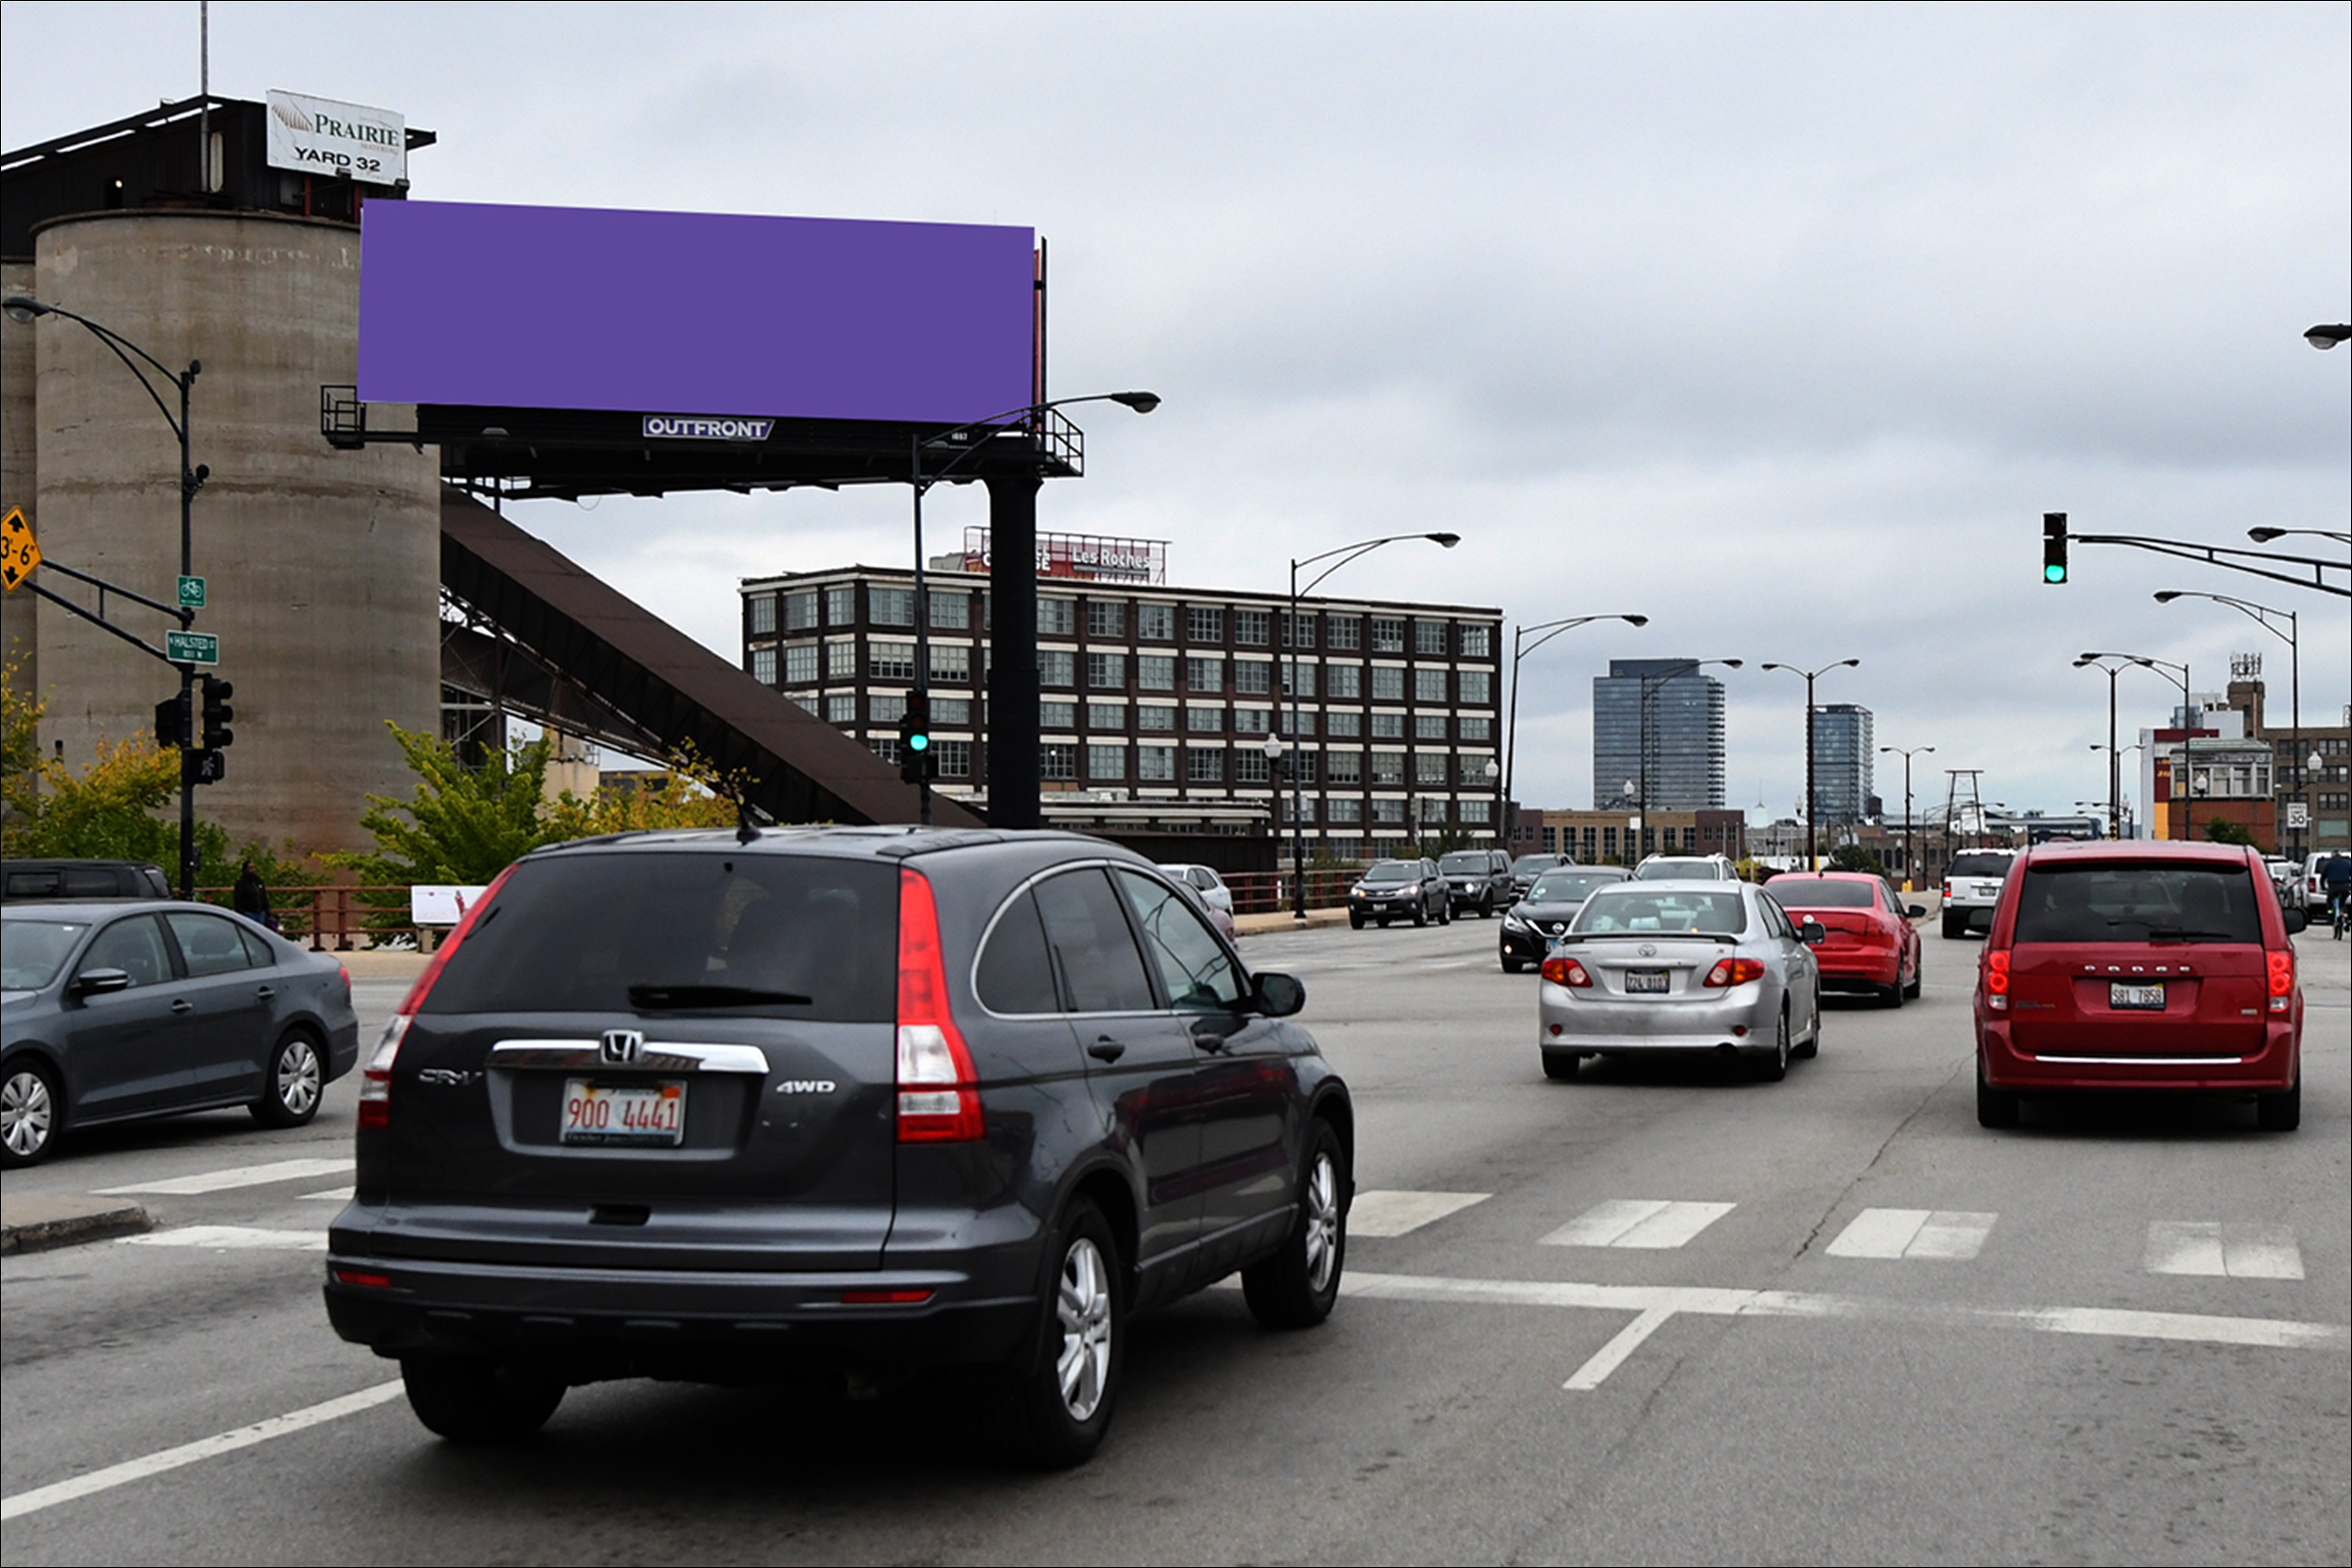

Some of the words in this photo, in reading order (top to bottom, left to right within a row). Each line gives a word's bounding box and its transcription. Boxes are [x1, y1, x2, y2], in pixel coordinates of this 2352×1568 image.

[315, 113, 400, 147] PRAIRIE
[294, 146, 351, 167] YARD
[356, 157, 381, 172] 32
[648, 418, 767, 437] OUTFRONT
[1072, 546, 1098, 564] Les
[1100, 549, 1151, 568] Roches
[173, 635, 209, 651] HALSTED
[2290, 814, 2305, 825] 30
[776, 1080, 836, 1095] 4WD
[568, 1098, 611, 1129] 900
[623, 1100, 675, 1131] 4441
